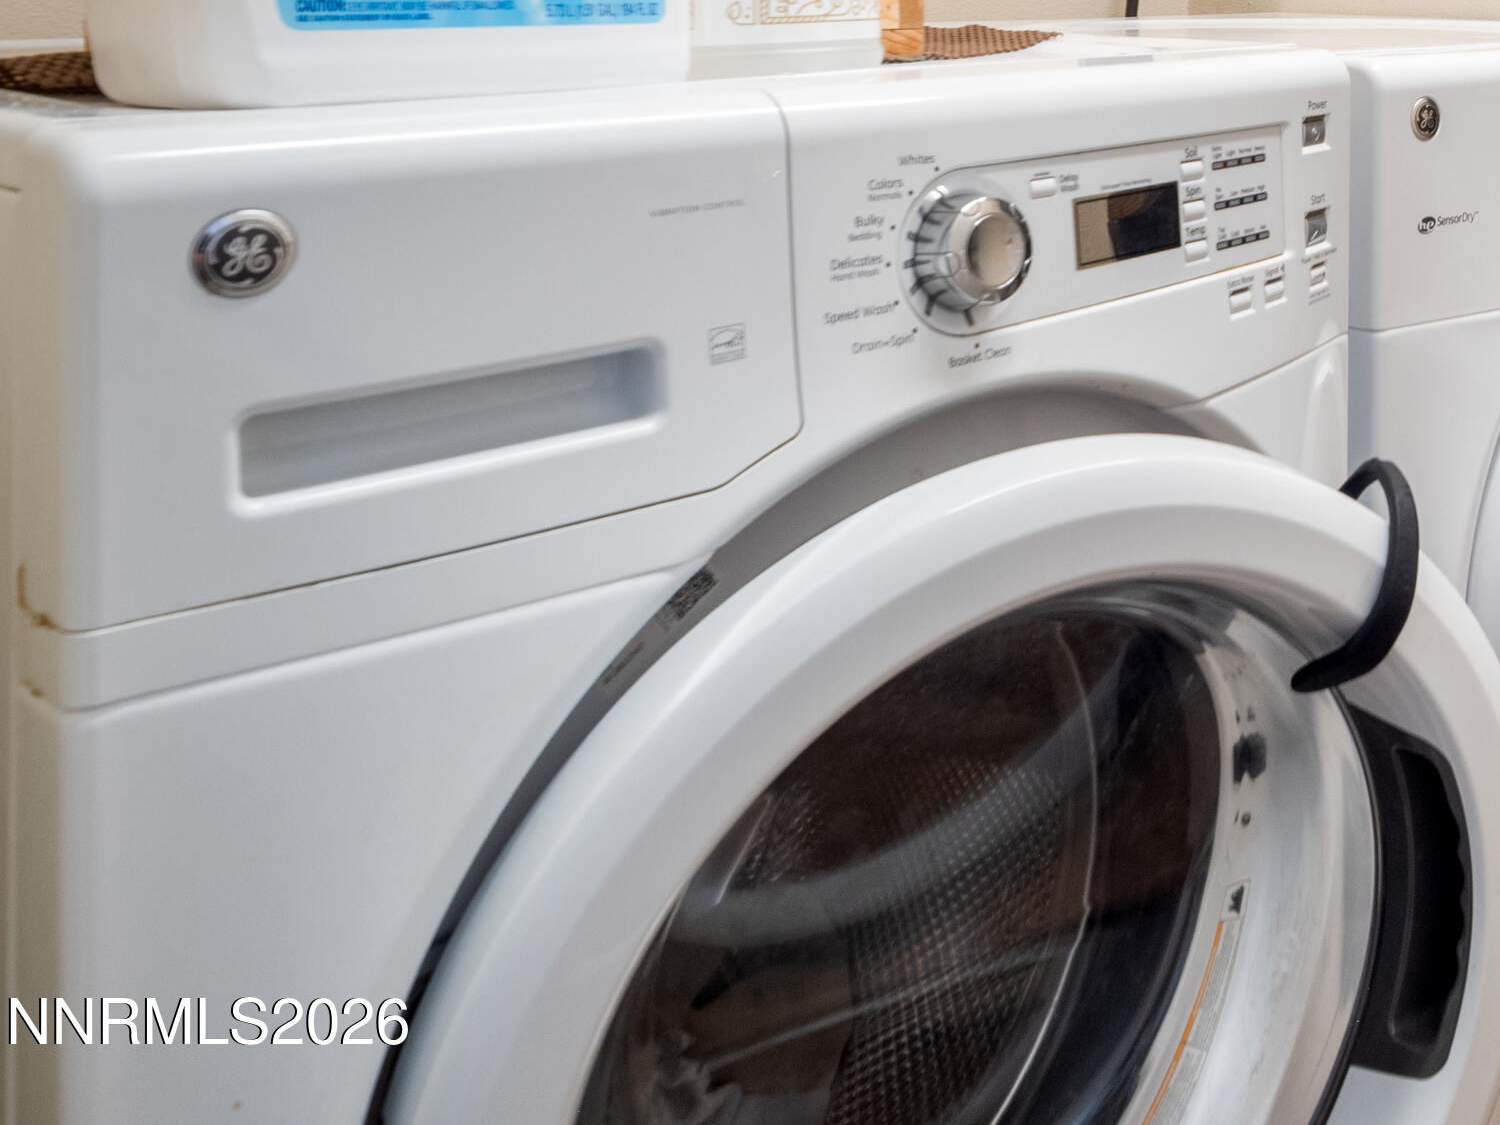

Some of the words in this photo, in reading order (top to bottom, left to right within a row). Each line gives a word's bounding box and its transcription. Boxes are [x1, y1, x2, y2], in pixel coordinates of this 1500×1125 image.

[1308, 100, 1328, 111] Power
[1184, 147, 1198, 159] Soil
[1185, 186, 1202, 198] Spin
[1310, 193, 1326, 206] Start
[854, 214, 886, 228] Bulky
[829, 254, 884, 271] Delicates
[823, 307, 861, 326] Speed
[863, 301, 896, 317] Wash
[948, 351, 983, 369] Basket
[984, 345, 1012, 361] Clean
